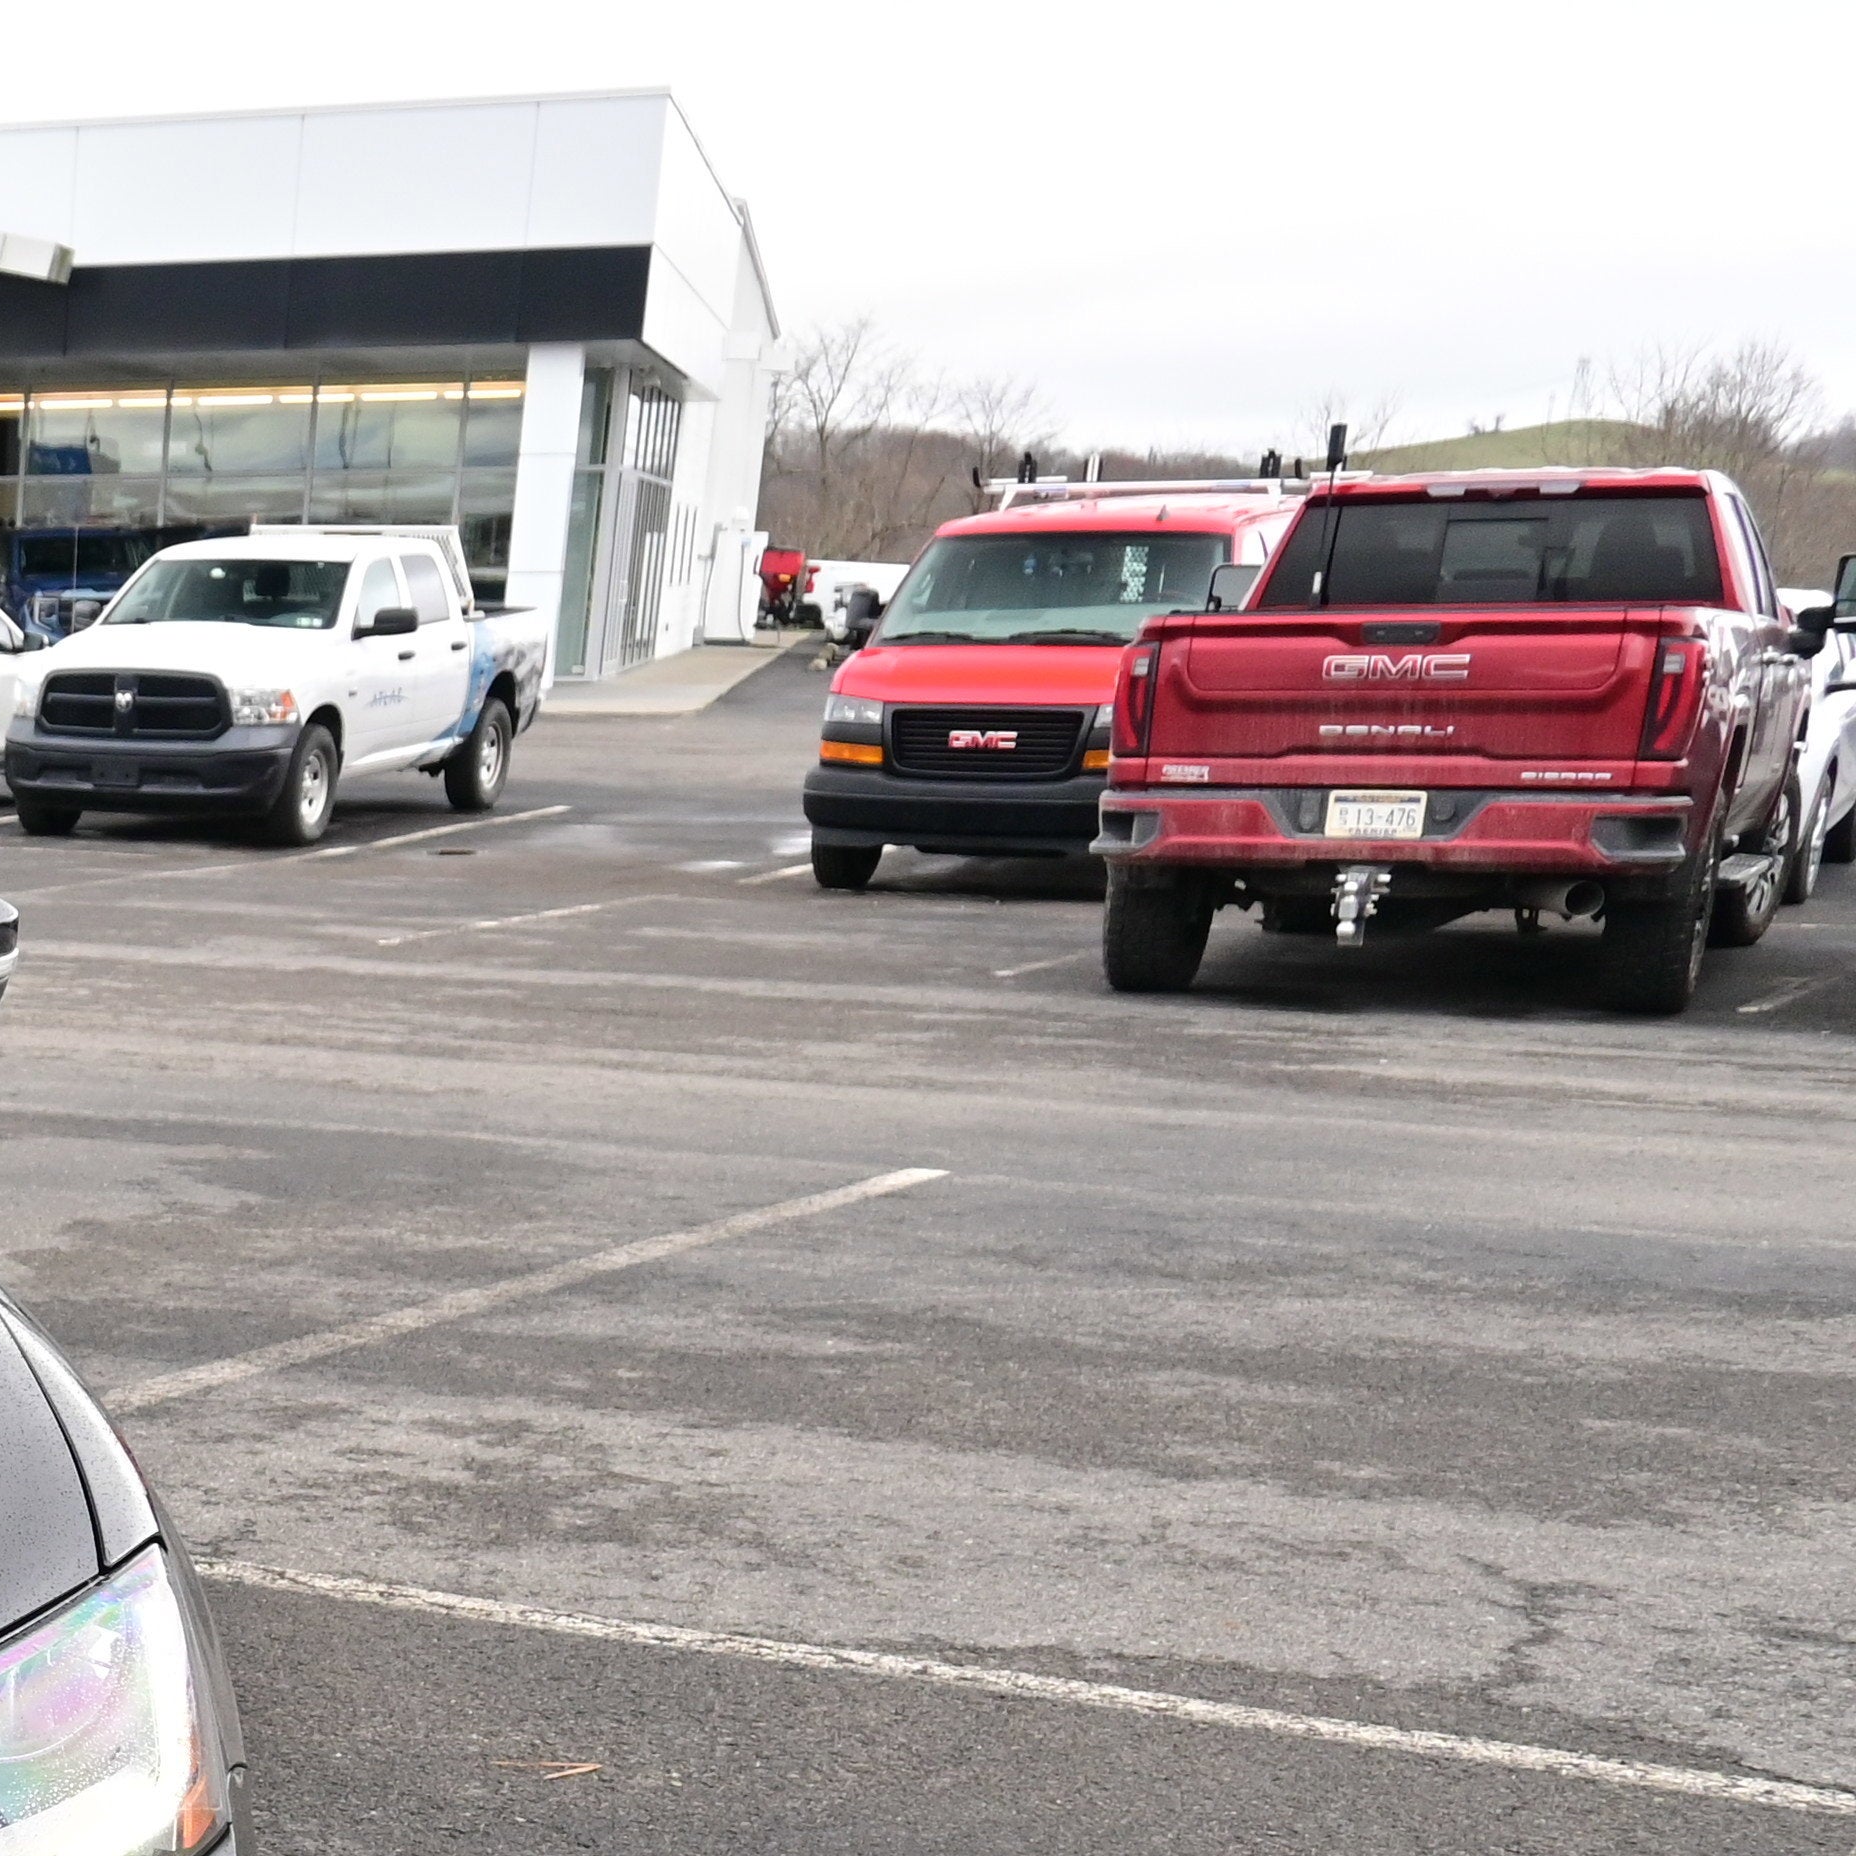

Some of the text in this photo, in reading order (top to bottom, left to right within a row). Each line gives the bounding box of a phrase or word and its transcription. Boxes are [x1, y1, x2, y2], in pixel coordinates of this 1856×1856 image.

[1322, 654, 1471, 681] GMC
[948, 730, 1018, 749] GMC
[1356, 808, 1417, 827] 13-476
